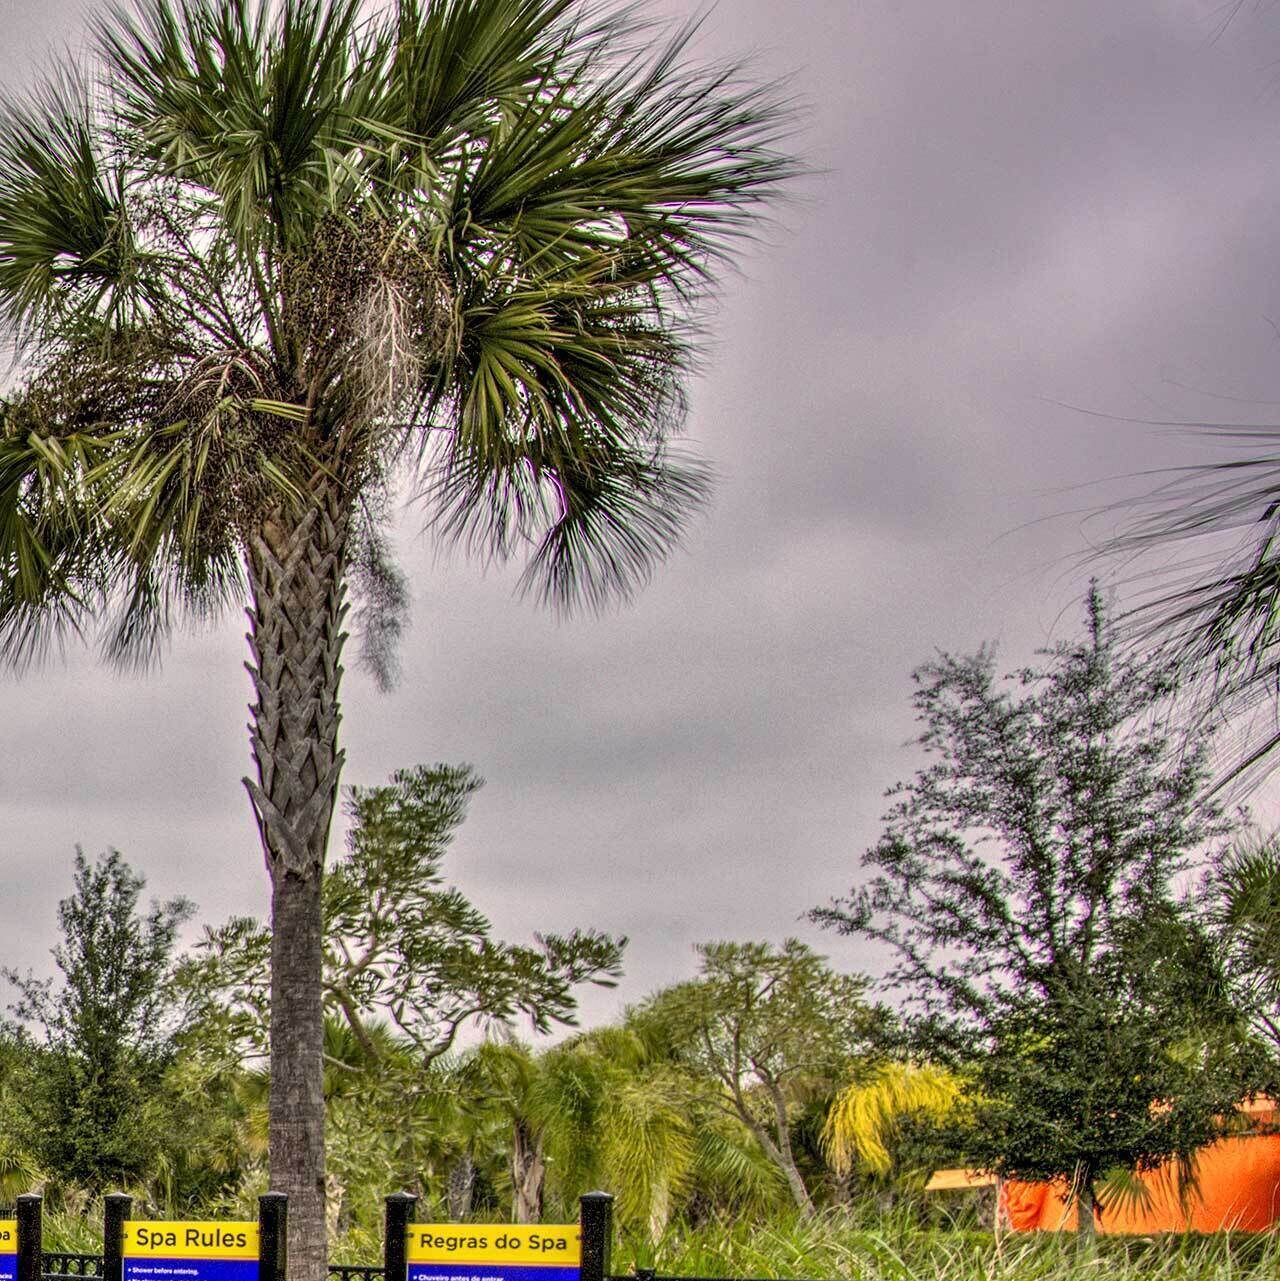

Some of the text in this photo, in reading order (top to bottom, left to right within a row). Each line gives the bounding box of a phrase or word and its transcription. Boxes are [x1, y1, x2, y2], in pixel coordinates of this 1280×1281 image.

[137, 1228, 247, 1250] Spa Rules
[420, 1234, 567, 1252] Regras do Spa
